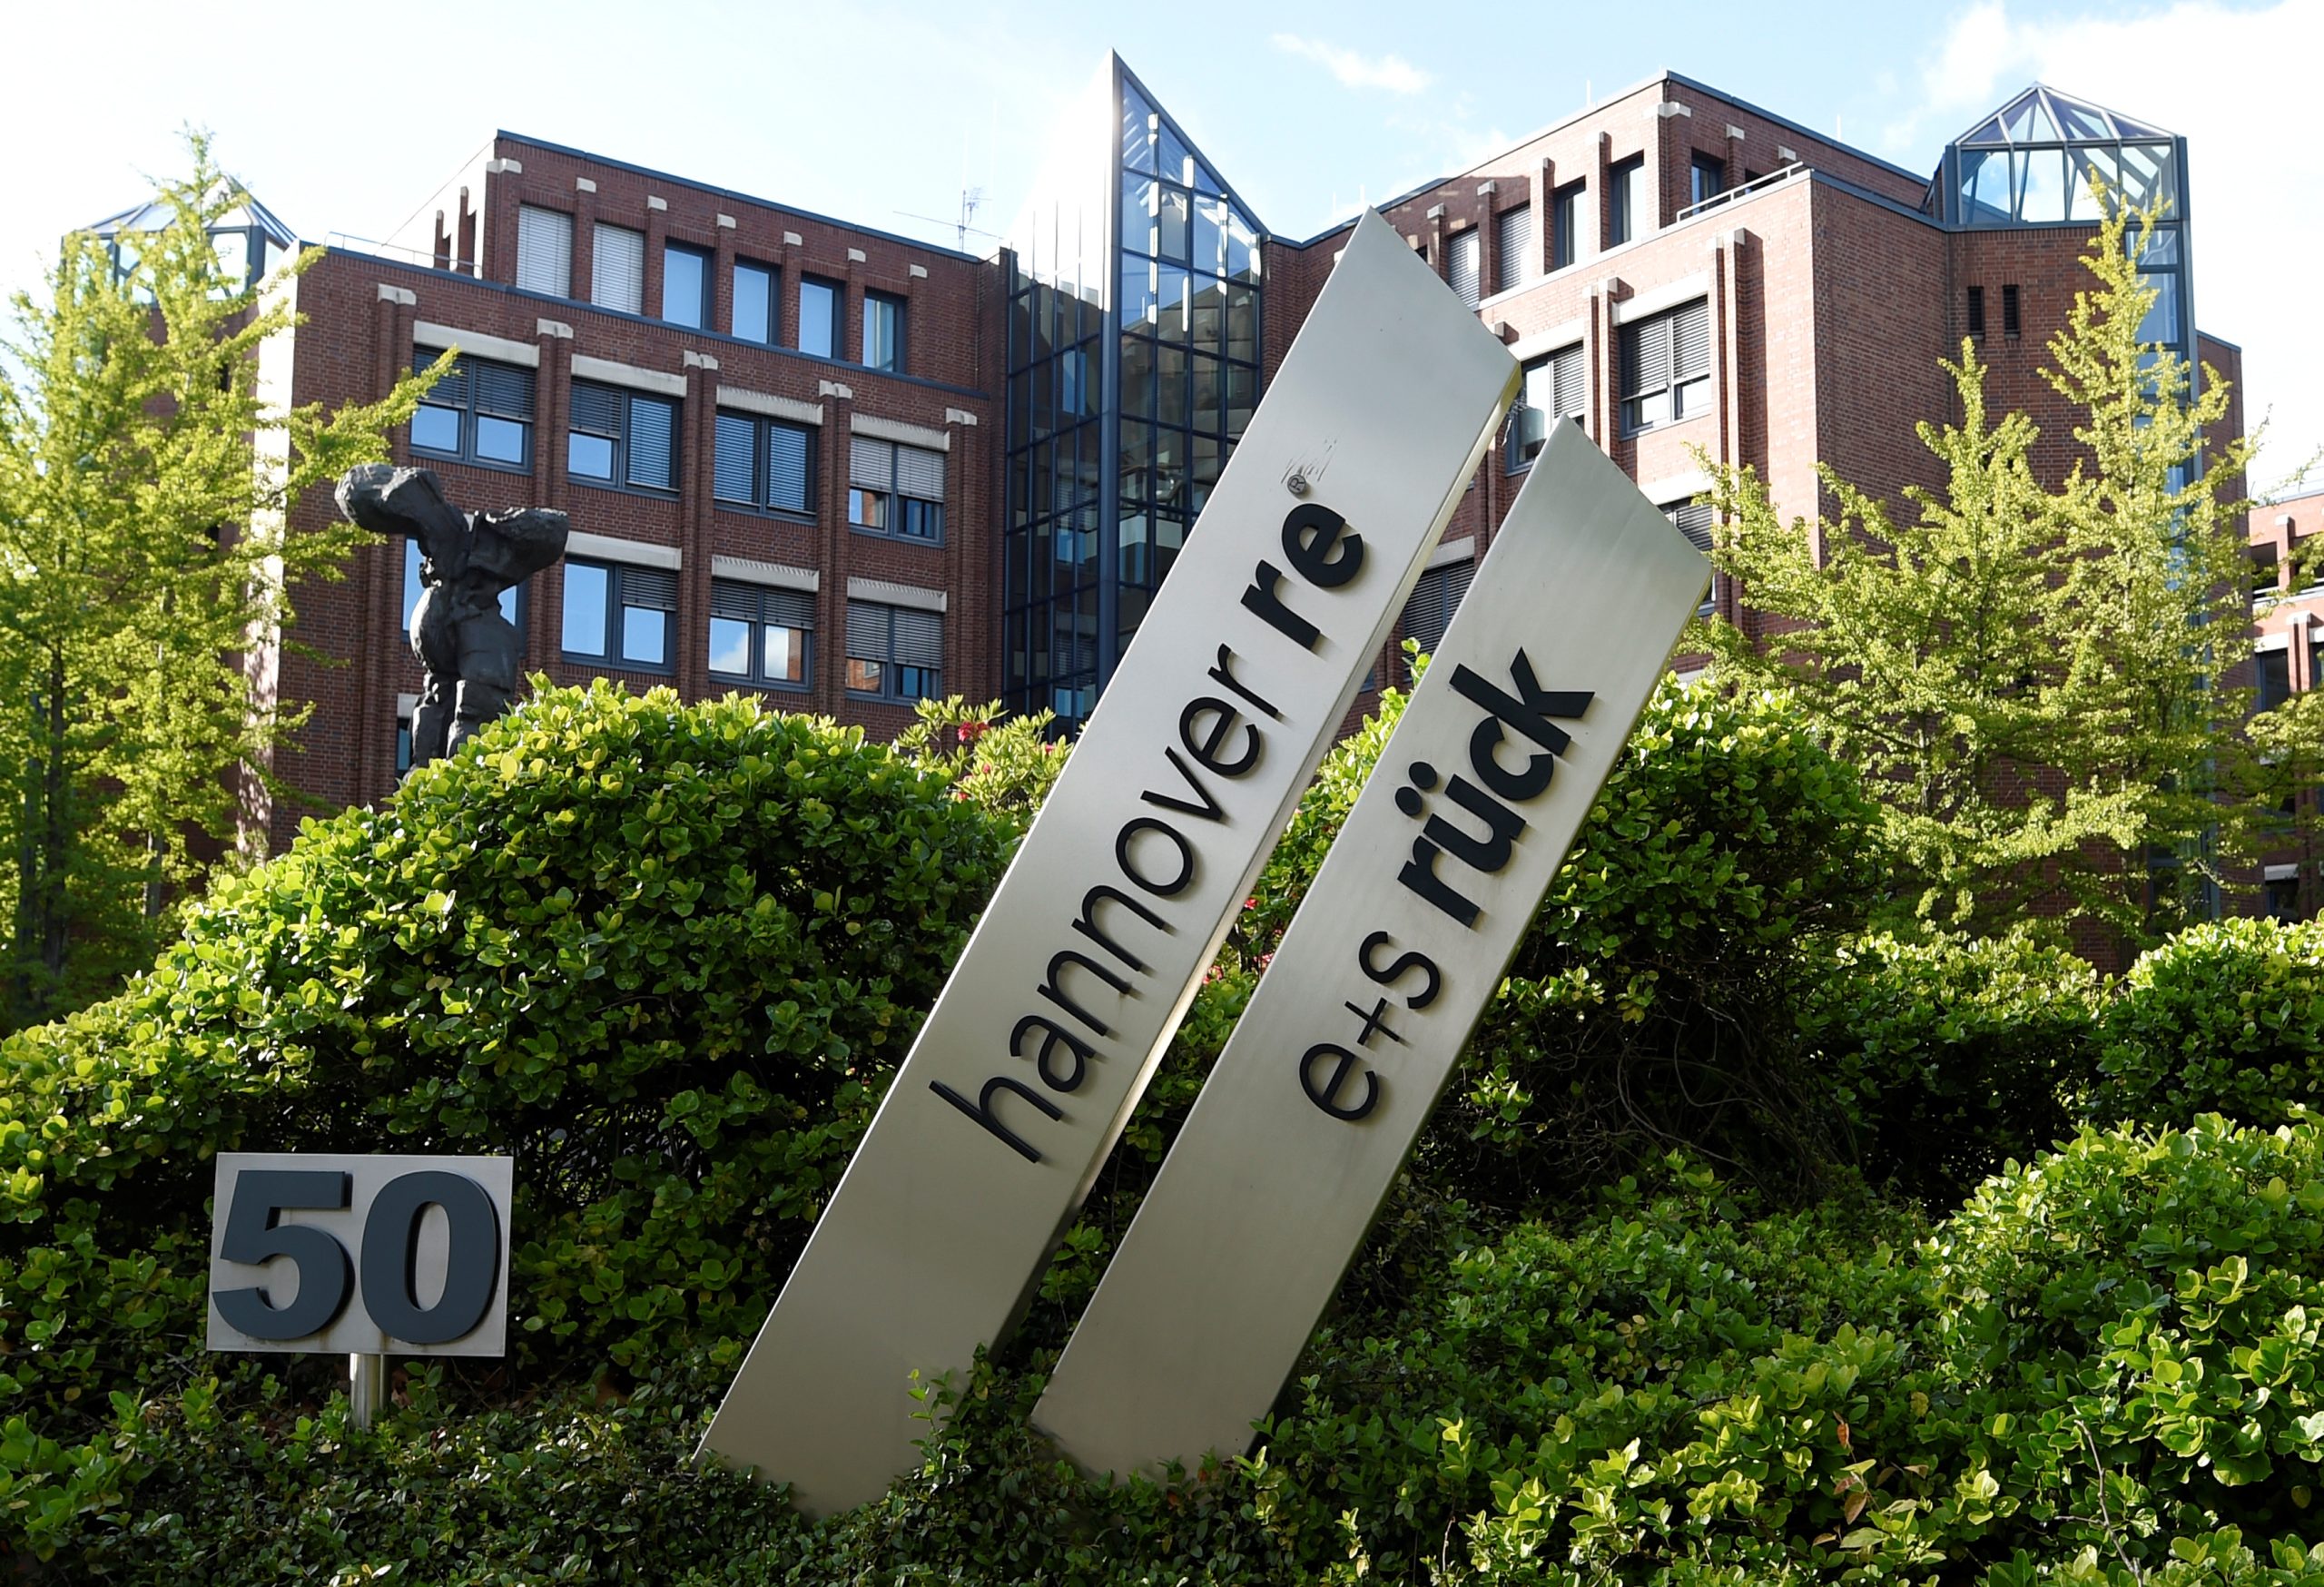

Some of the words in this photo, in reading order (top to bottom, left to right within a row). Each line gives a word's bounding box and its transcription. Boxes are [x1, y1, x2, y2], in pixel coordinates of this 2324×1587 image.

[930, 643, 1279, 1163] hannover
[1299, 931, 1441, 1121] e+s
[1394, 646, 1595, 929] rück
[212, 1169, 502, 1345] 50
